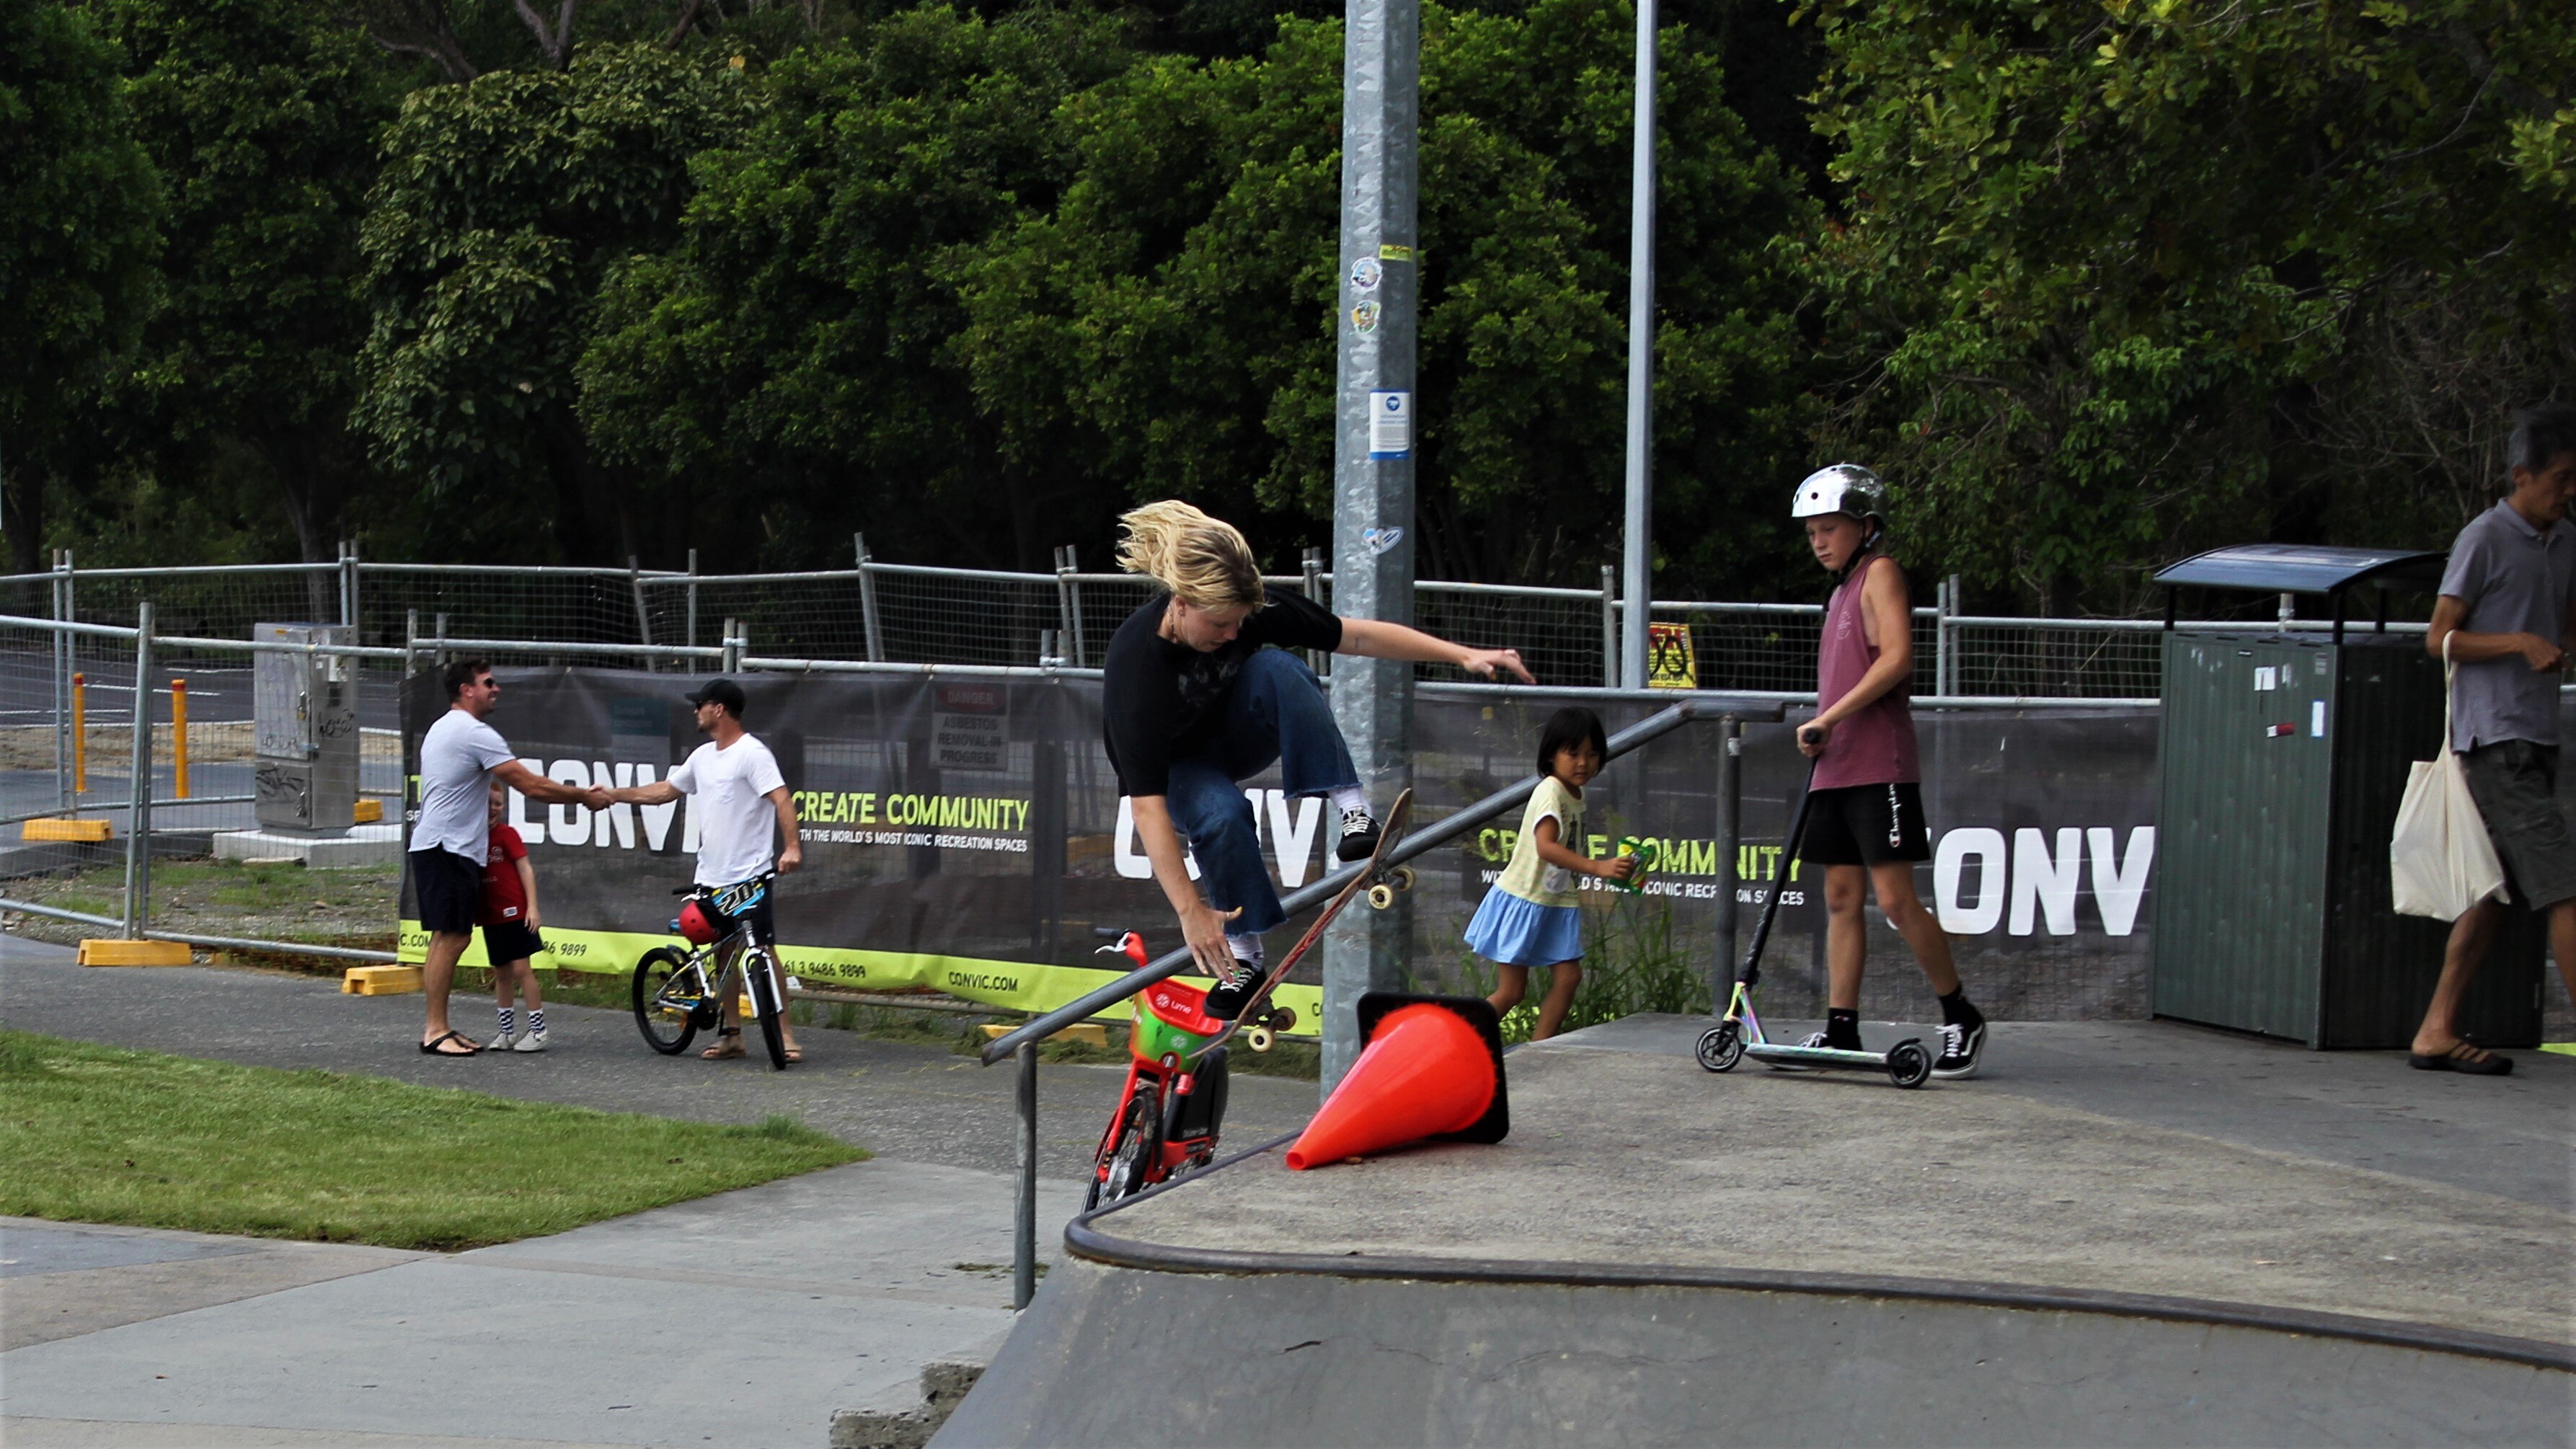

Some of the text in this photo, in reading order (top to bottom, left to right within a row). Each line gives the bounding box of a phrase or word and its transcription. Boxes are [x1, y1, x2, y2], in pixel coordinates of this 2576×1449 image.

[792, 791, 1029, 831] CREATE COMMUNITY
[813, 830, 829, 842] THE
[831, 830, 872, 843] WORLD'S
[875, 832, 902, 845] MOST
[903, 833, 931, 846] ICONIC
[934, 834, 993, 850] RECREATION
[994, 837, 1027, 852] SPACES
[560, 943, 587, 957] 9899
[800, 961, 805, 974] 3
[810, 962, 836, 976] 9486
[839, 965, 866, 978] 9899
[949, 972, 1017, 992] CONVIC.COM
